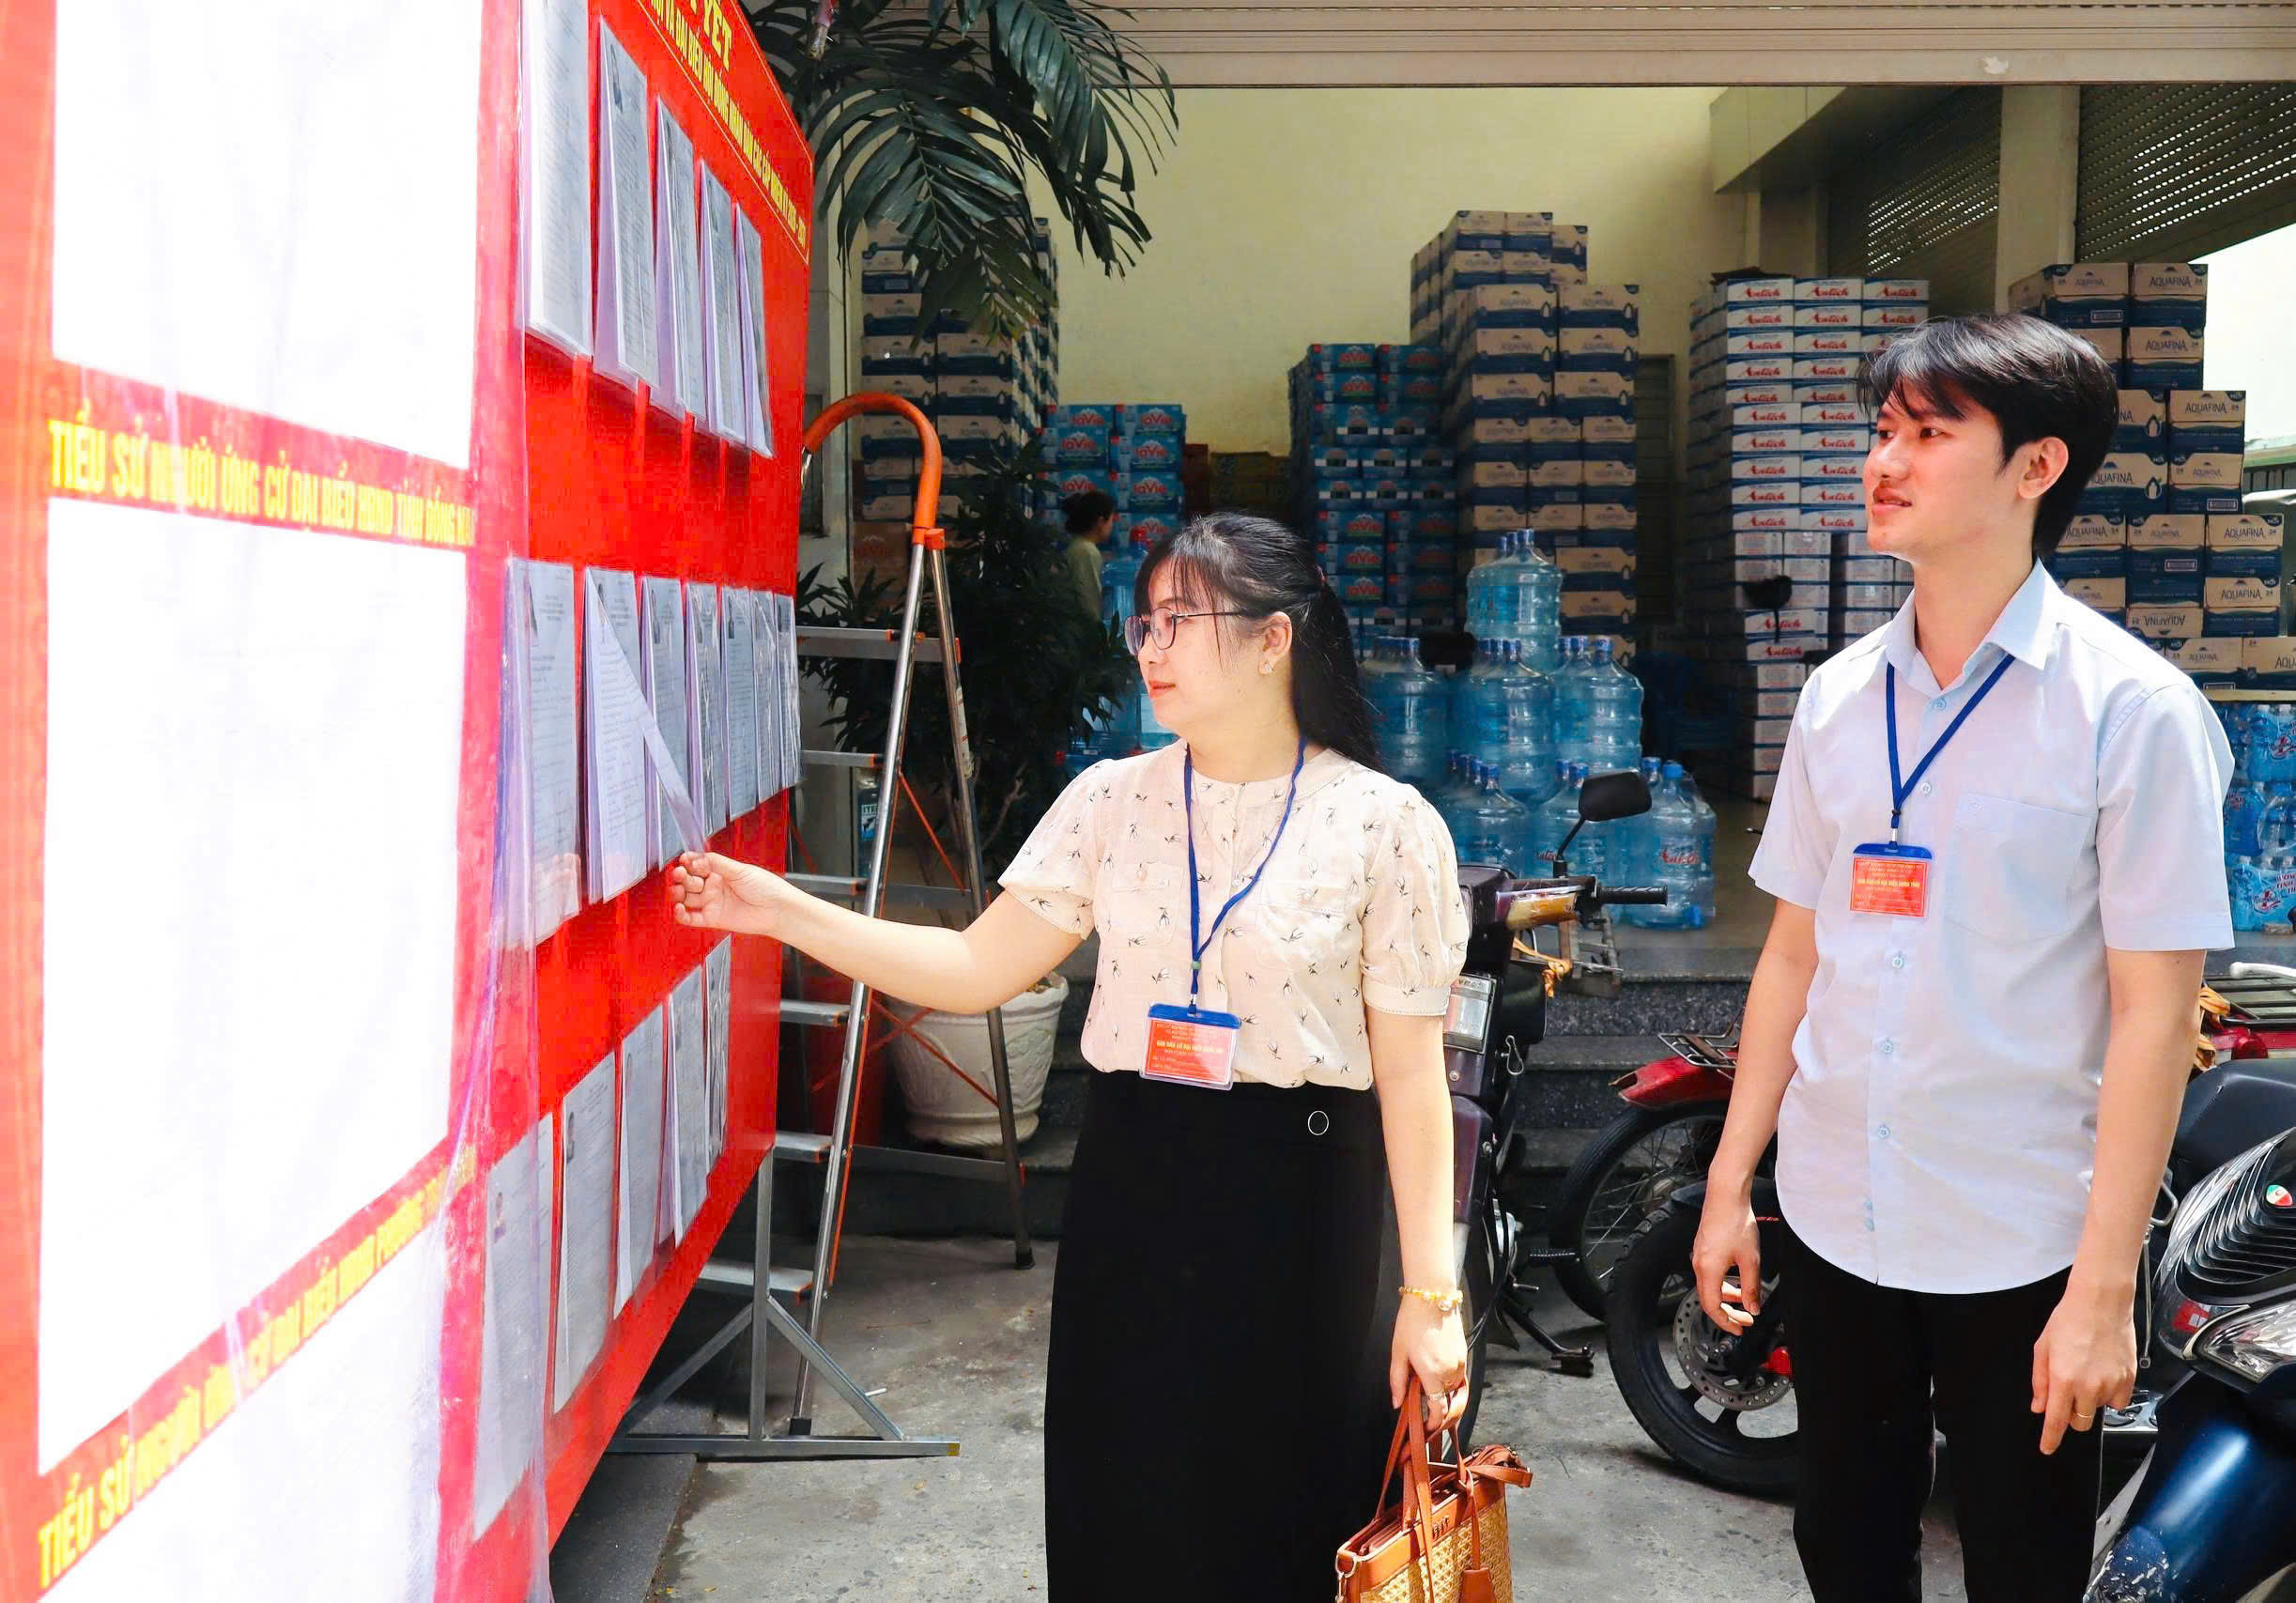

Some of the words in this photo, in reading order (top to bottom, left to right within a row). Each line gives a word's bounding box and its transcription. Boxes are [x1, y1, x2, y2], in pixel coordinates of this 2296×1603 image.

[2150, 277, 2193, 288] AQUAFINA
[2146, 339, 2187, 351] AQUAFINA
[2185, 403, 2227, 413] AQUAFINA
[48, 397, 106, 492] TIỂU
[112, 415, 146, 498] SỬ
[265, 450, 289, 519] CỬ
[322, 460, 355, 529] BIỂU
[2094, 471, 2134, 485] QUAFINA
[2224, 527, 2265, 539] AQUAFINA
[2221, 588, 2262, 601] AQUAFINA
[39, 1473, 94, 1589] TIỂU
[98, 1435, 133, 1531] SỬ
